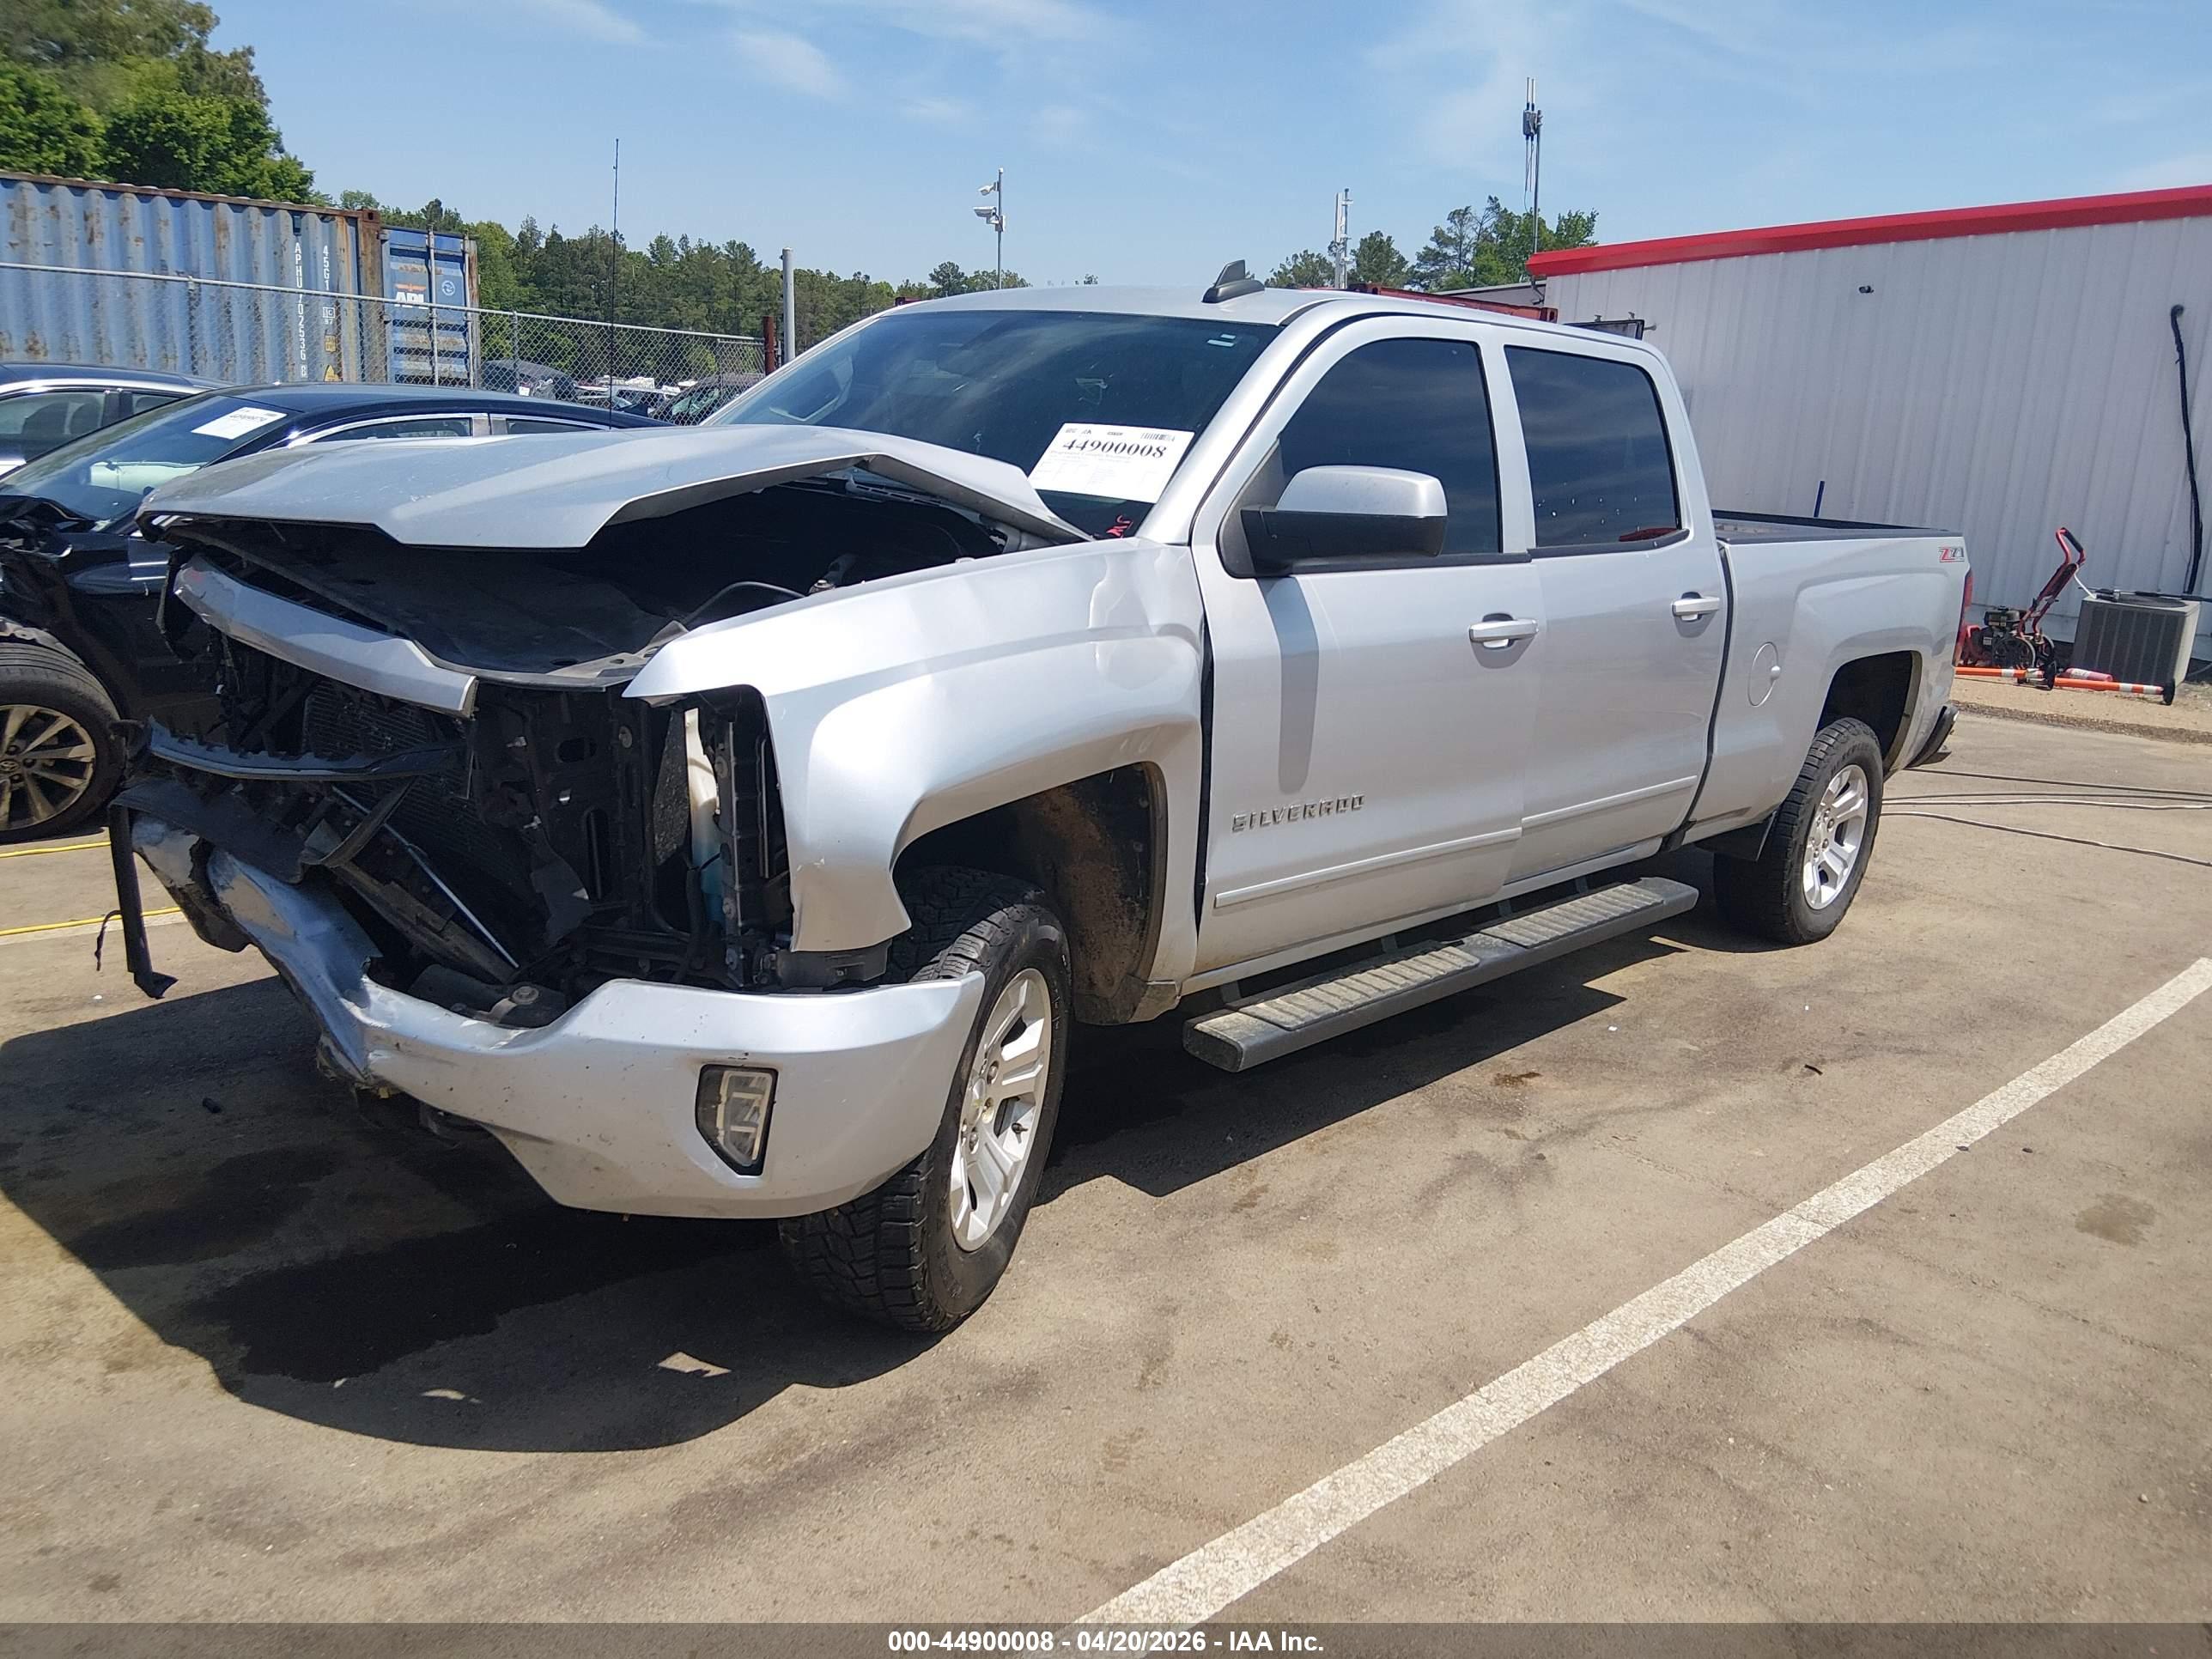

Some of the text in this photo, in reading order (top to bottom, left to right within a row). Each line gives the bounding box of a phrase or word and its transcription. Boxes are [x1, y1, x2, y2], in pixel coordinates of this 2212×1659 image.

[295, 242, 303, 289] APHU
[394, 291, 429, 310] APL
[1063, 439, 1167, 459] 44900008
[1938, 546, 1965, 562] Z71
[1232, 793, 1365, 833] SILVERADO
